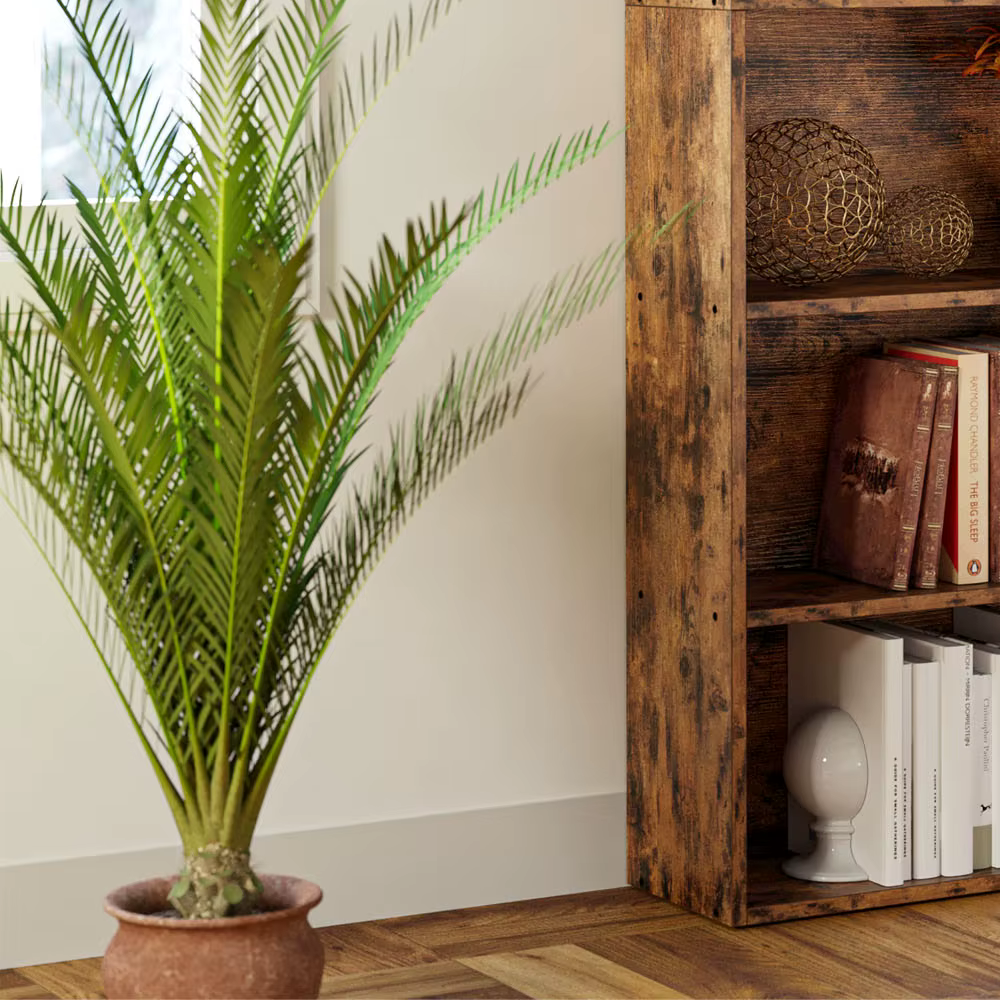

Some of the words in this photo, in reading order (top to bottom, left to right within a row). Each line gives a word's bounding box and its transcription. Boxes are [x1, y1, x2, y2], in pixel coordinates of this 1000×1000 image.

[970, 376, 978, 422] RAYMOND
[970, 424, 978, 474] CHANDLER
[970, 480, 978, 498] THE
[970, 501, 978, 516] BIG
[970, 520, 978, 543] SLEEP
